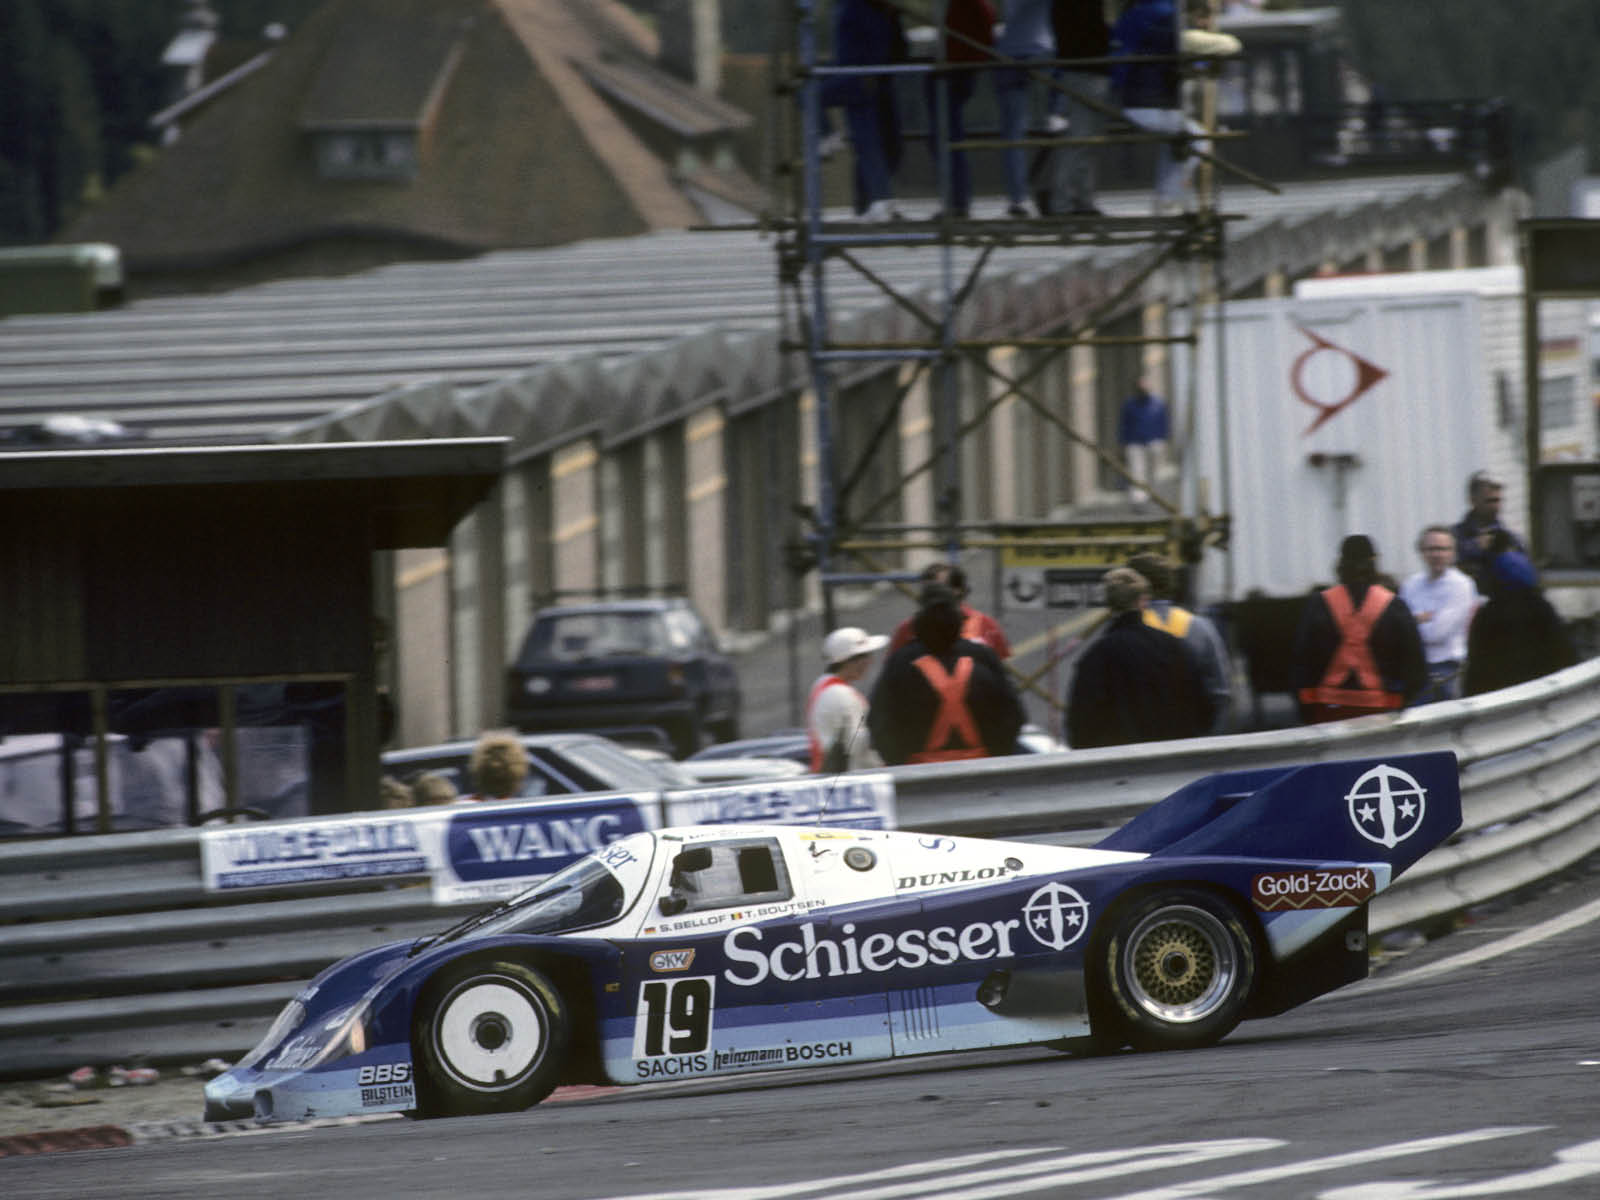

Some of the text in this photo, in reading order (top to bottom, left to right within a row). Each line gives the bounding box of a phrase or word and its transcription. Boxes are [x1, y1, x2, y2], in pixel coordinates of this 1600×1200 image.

[1257, 869, 1369, 896] Gold-Zack
[758, 899, 827, 917] BOUTSEN
[674, 914, 728, 931] BELLOF
[723, 918, 1020, 987] Schiesser
[643, 979, 711, 1057] 19
[713, 1047, 784, 1071] heinzmann
[785, 1041, 853, 1061] BOSCH
[358, 1063, 409, 1086] BBS
[636, 1055, 708, 1078] SACHS
[361, 1084, 413, 1102] BILSTEIN
